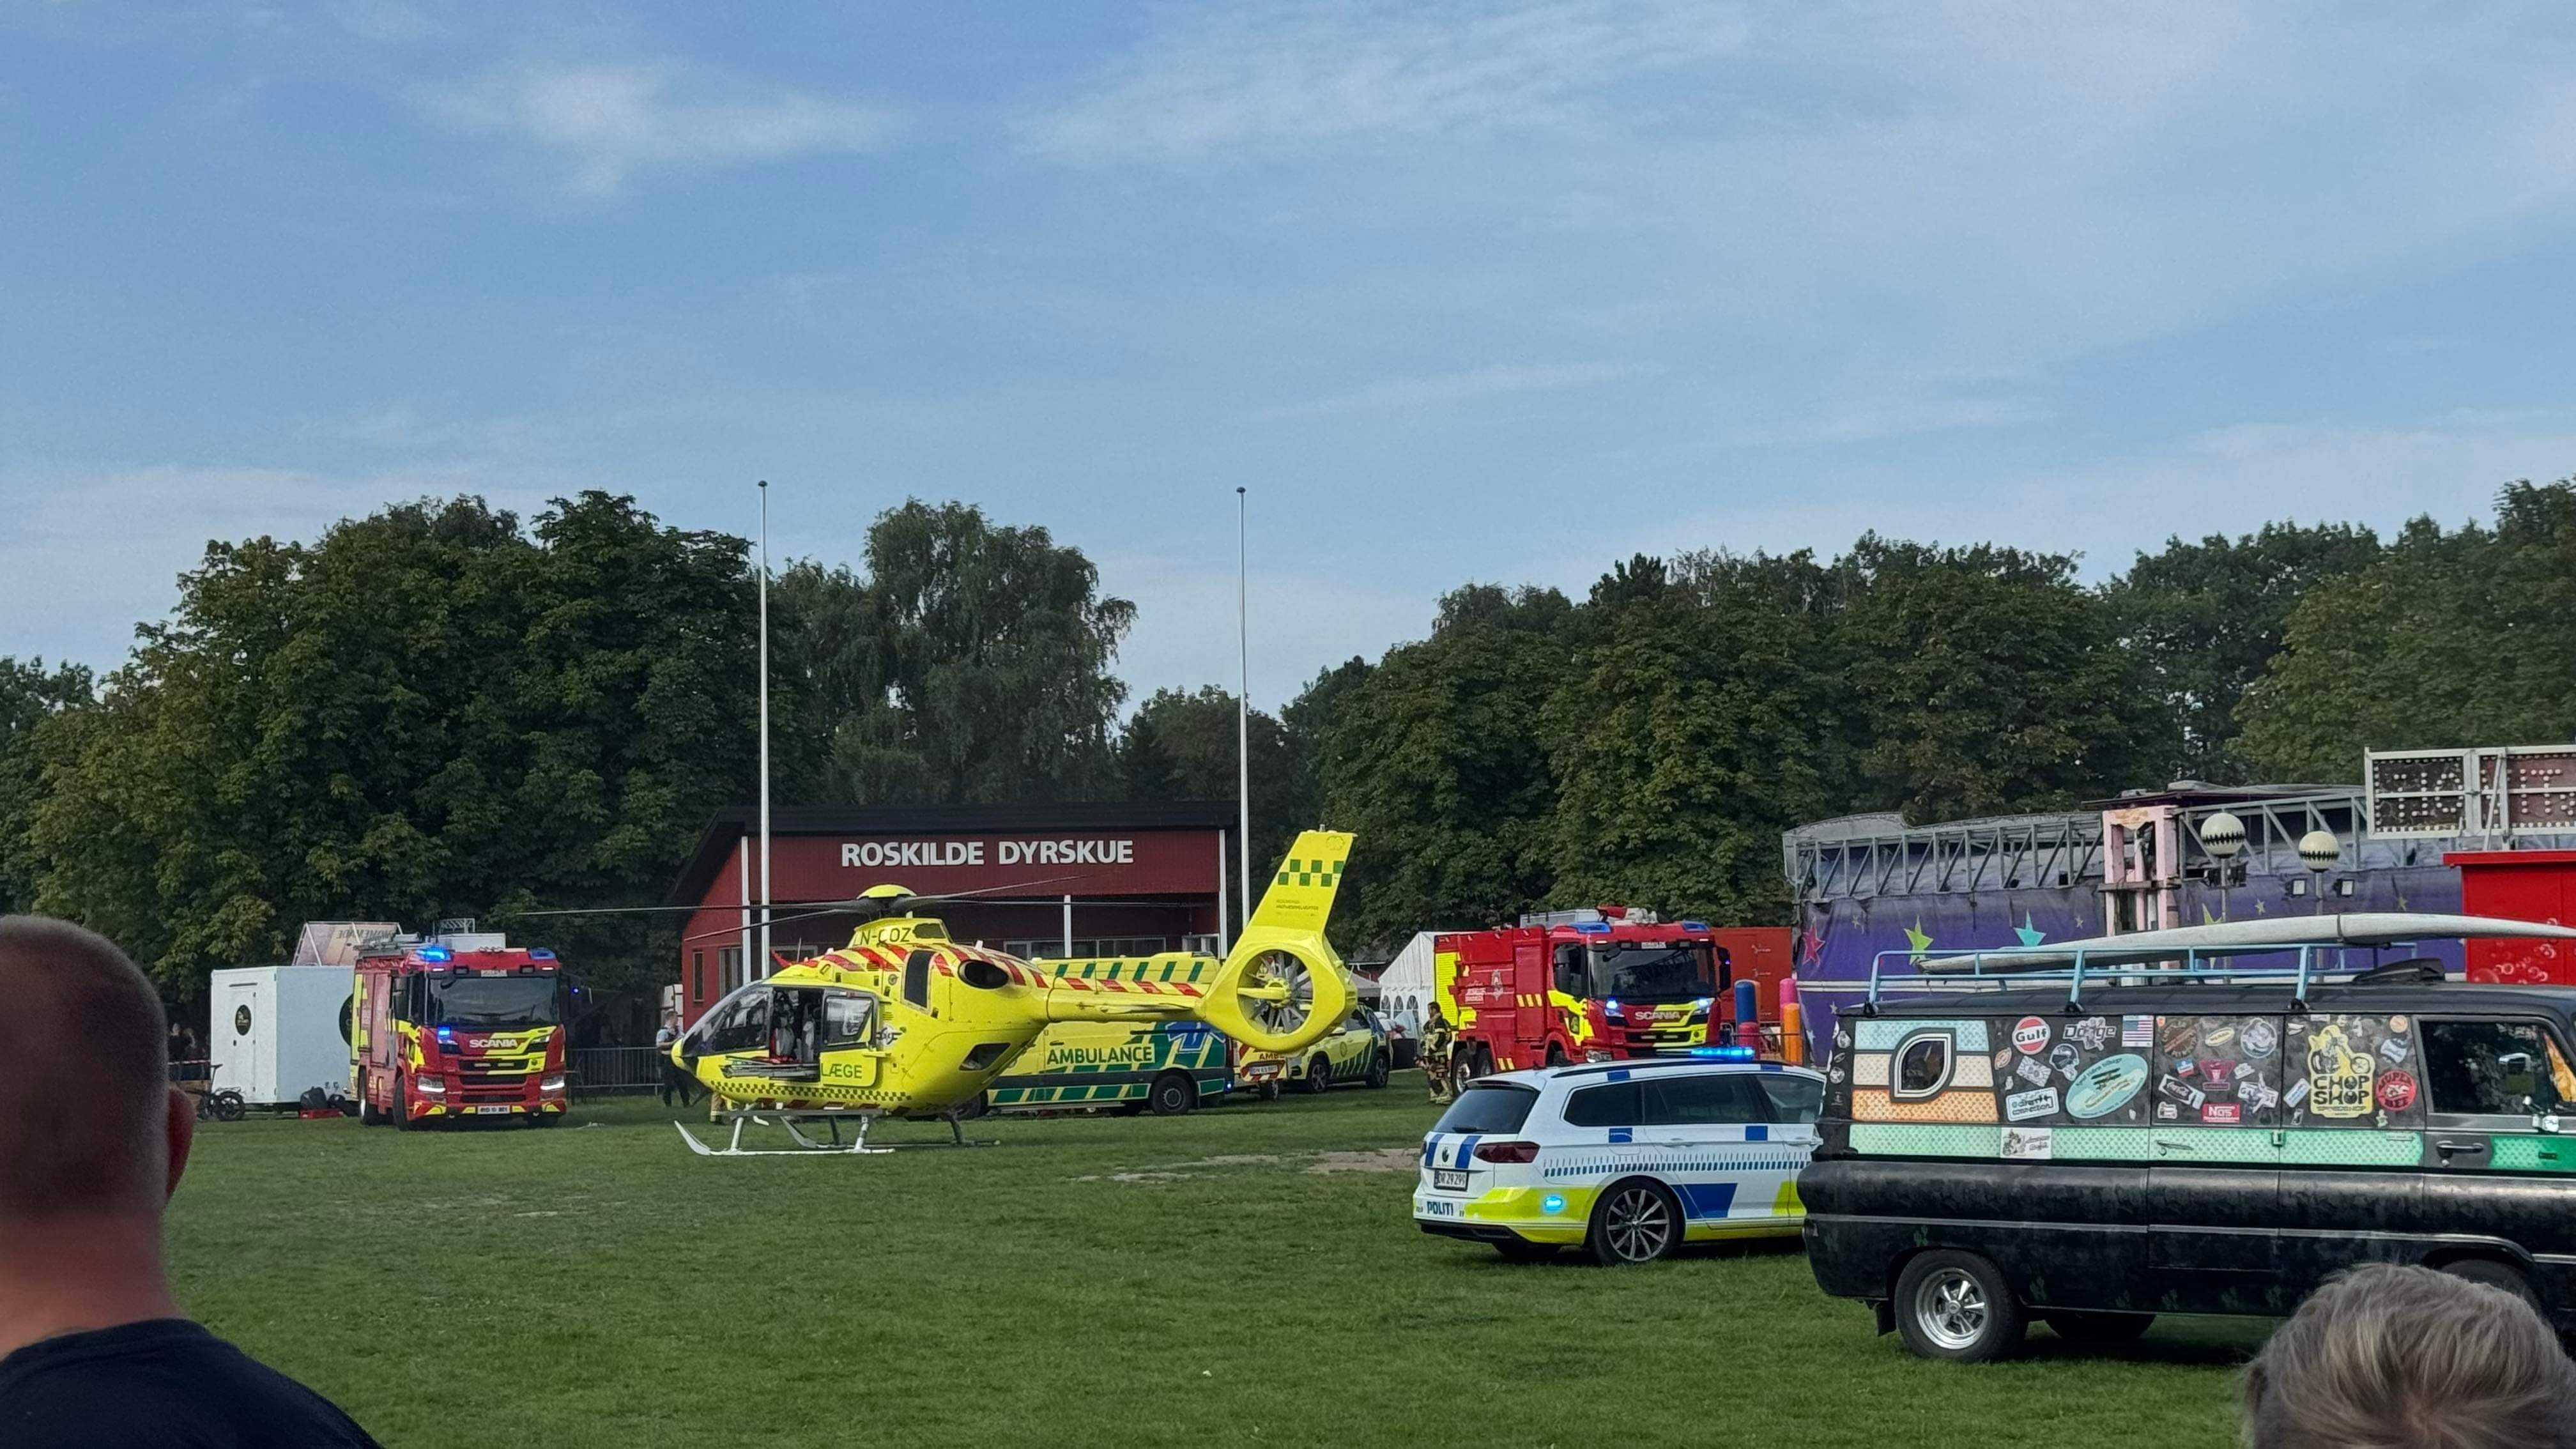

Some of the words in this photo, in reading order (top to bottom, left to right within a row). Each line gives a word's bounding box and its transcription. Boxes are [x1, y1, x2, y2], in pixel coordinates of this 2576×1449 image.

[841, 841, 985, 867] ROSKILDE
[999, 840, 1134, 865] DYRSKUE
[1635, 1011, 1680, 1020] SCANIA
[2016, 1028, 2048, 1042] Gulf
[469, 1039, 518, 1048] SCANIA
[1046, 1046, 1153, 1065] AMBULANCE
[821, 1063, 862, 1079] LÆGE
[2313, 1075, 2370, 1090] CHOP
[2313, 1090, 2370, 1105] SHOP
[1427, 1201, 1453, 1216] POLITI
